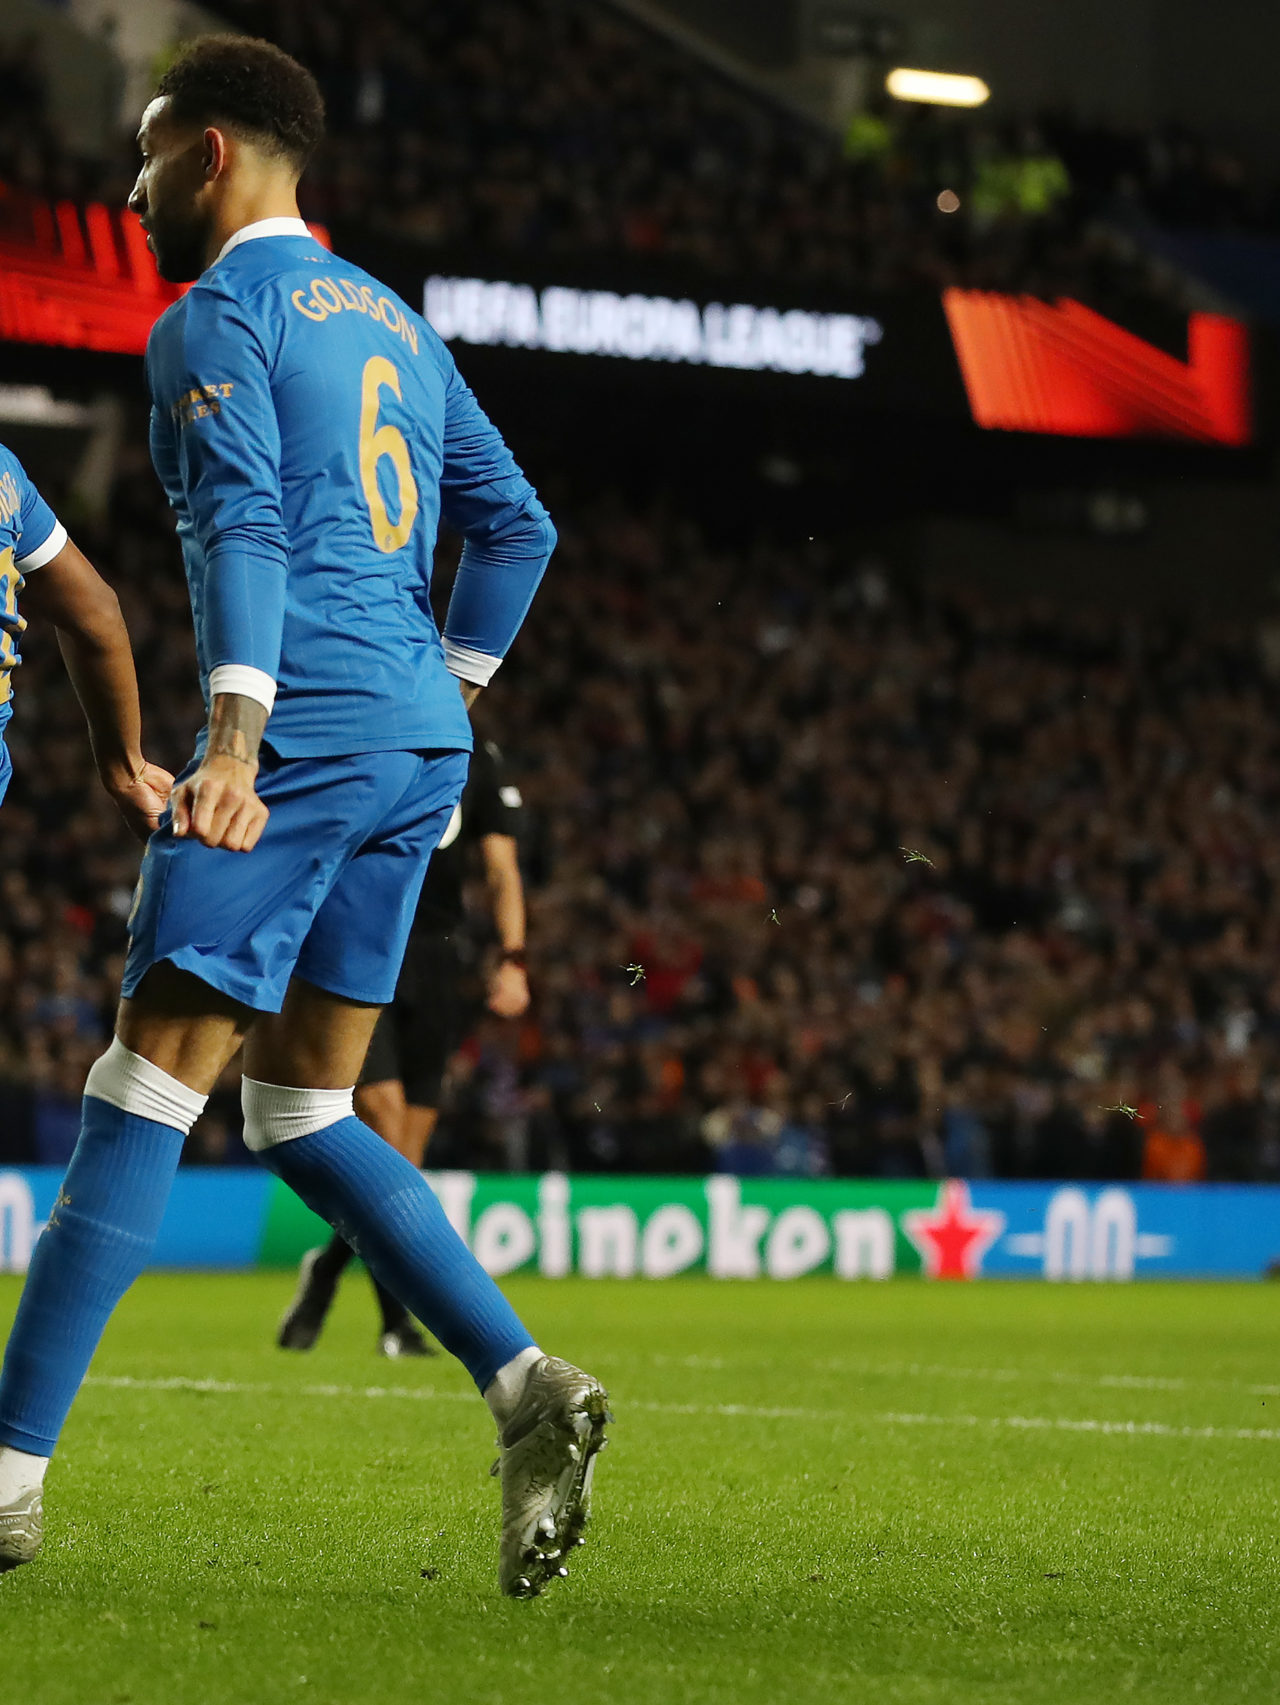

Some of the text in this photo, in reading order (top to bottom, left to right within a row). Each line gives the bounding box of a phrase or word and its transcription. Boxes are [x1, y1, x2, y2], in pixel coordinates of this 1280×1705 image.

[291, 276, 419, 355] GOLDSON
[424, 275, 540, 349] UEFA
[541, 286, 703, 363] EUROPA
[359, 355, 419, 553] 6
